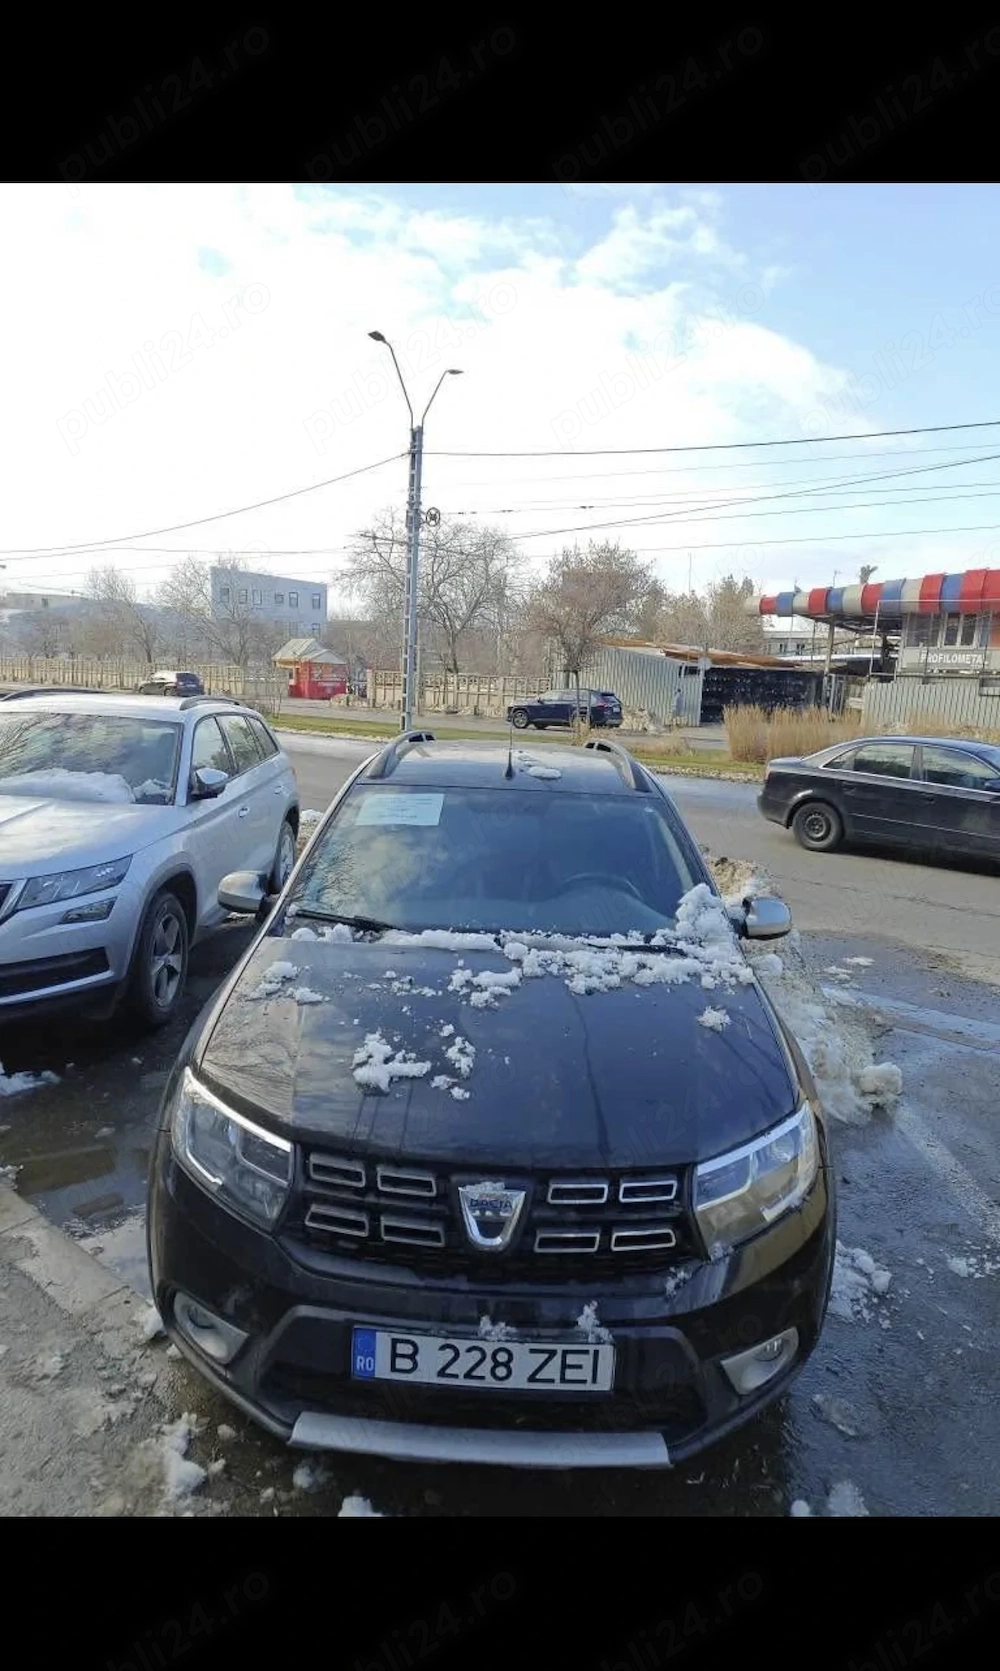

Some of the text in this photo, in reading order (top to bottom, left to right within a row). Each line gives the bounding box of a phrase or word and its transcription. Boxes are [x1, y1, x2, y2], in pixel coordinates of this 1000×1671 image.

[469, 1198, 513, 1210] DACIA
[356, 1337, 600, 1385] RO B 228 ZEI
